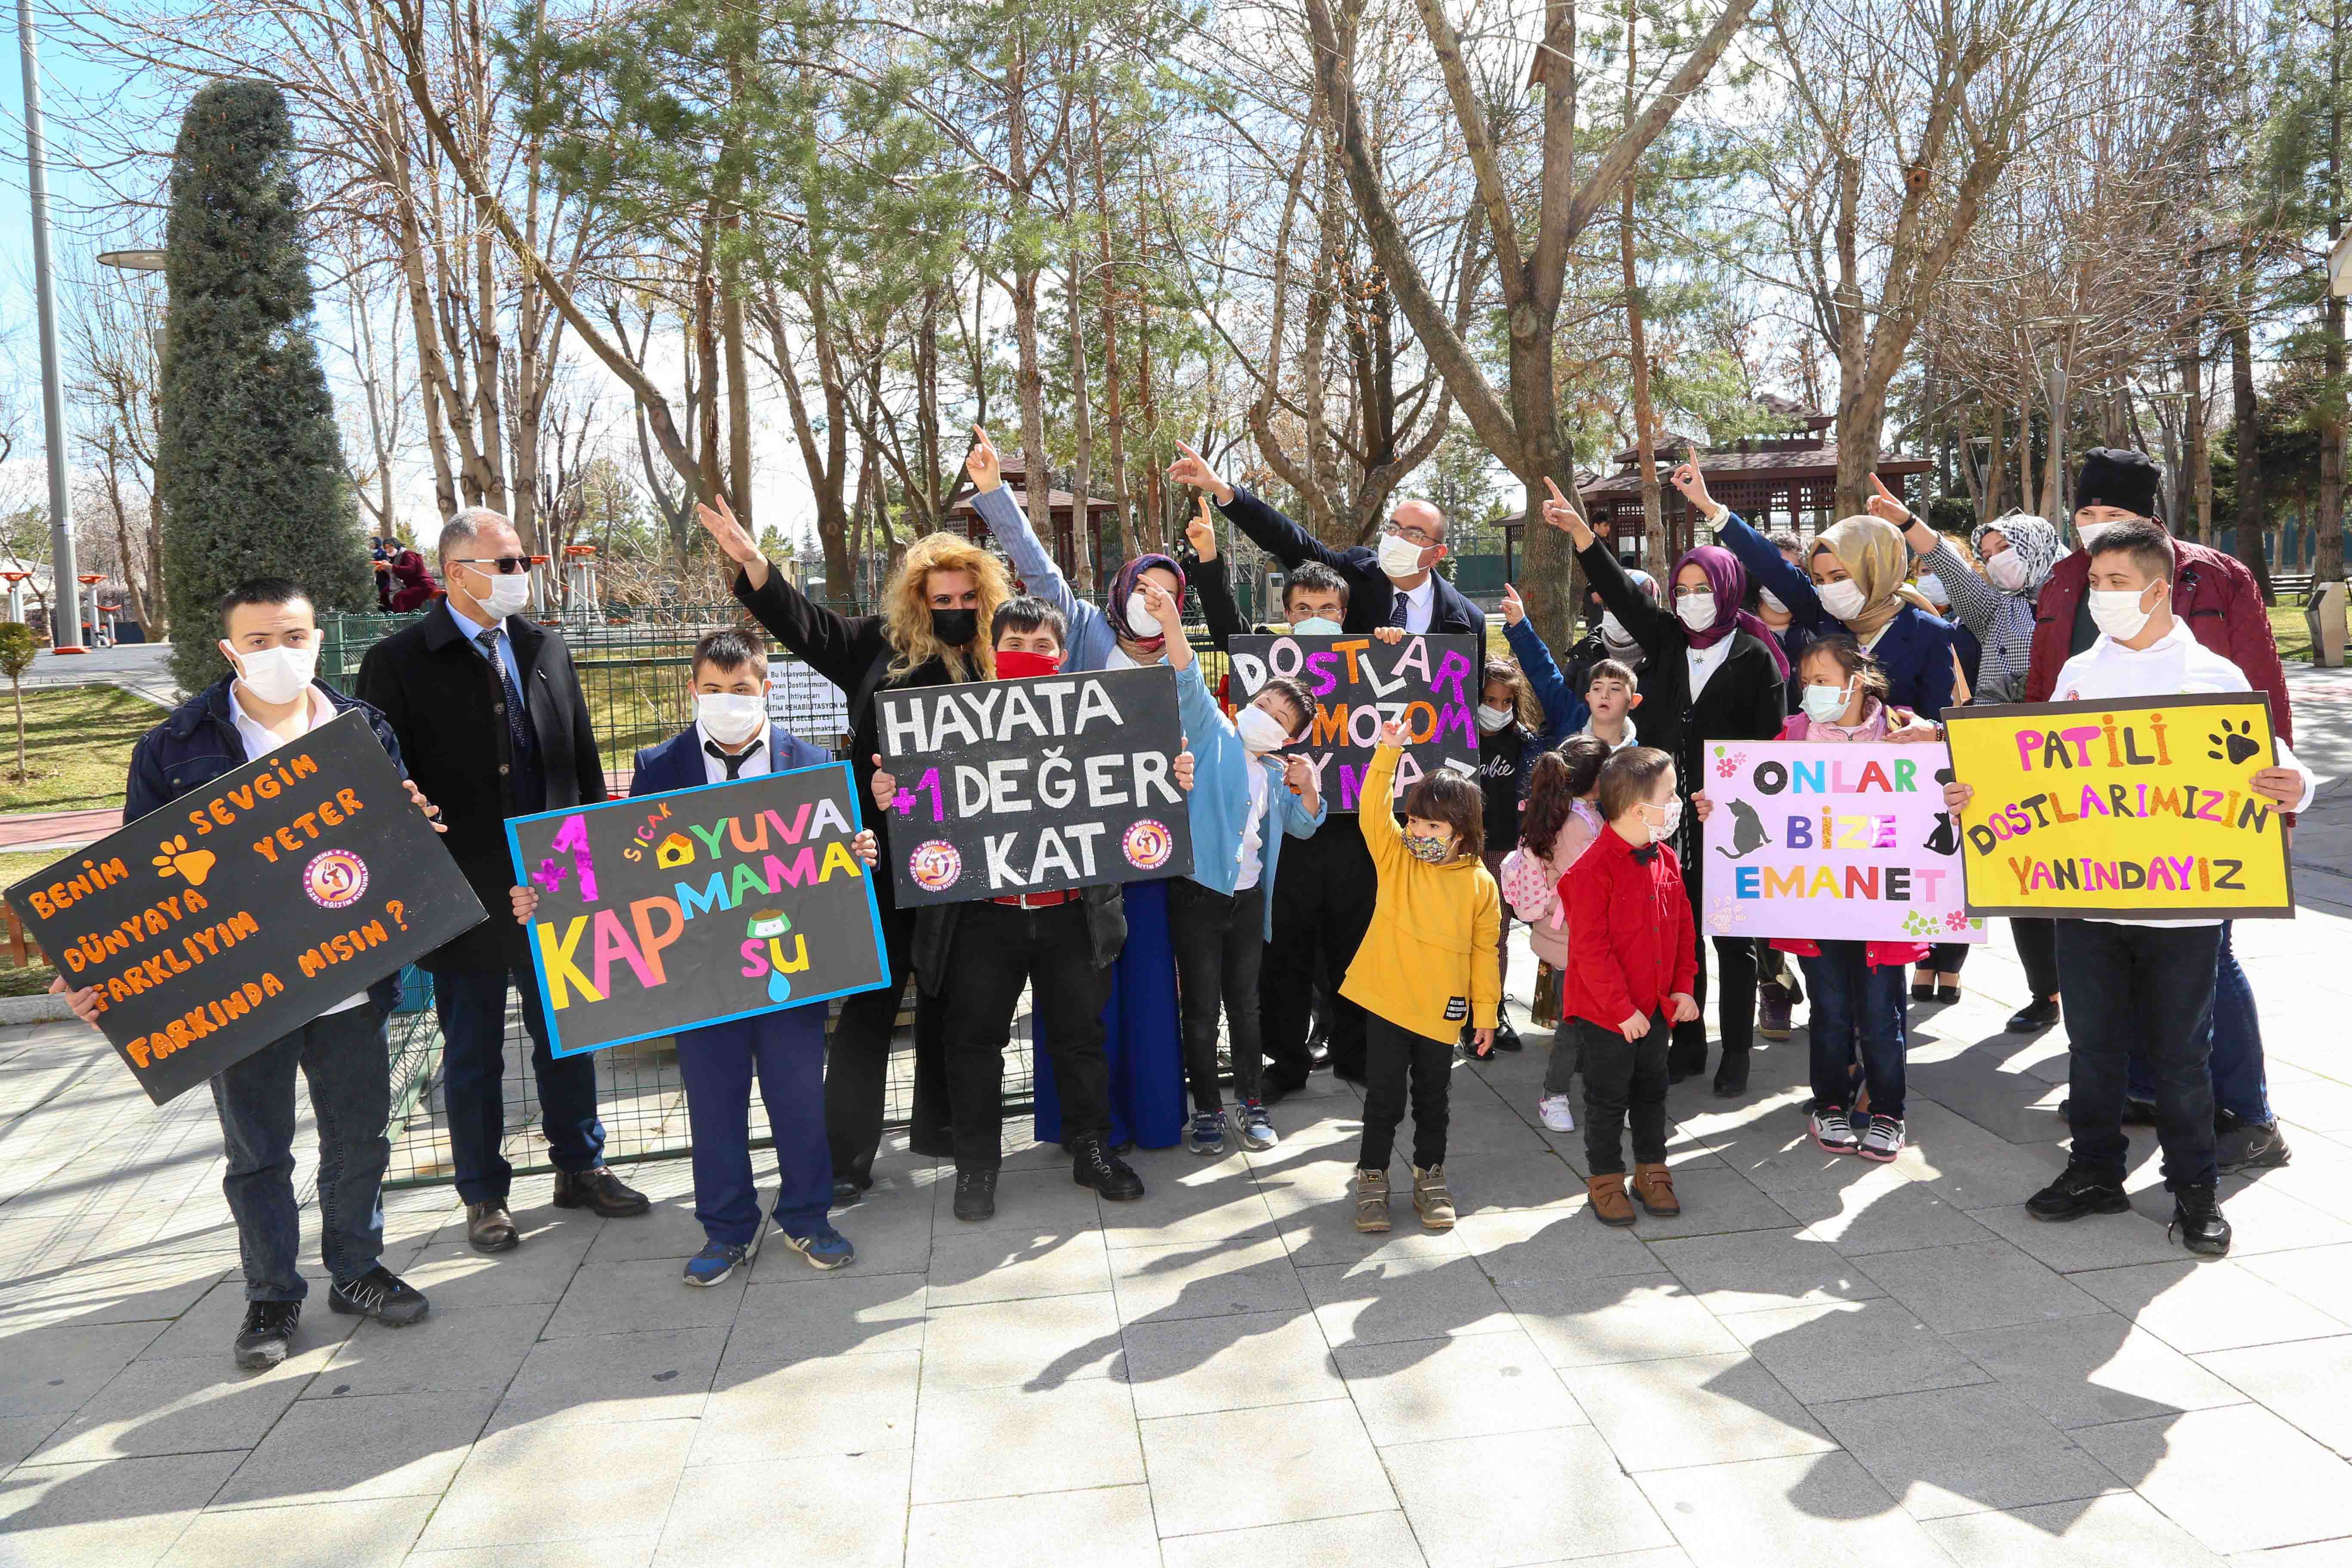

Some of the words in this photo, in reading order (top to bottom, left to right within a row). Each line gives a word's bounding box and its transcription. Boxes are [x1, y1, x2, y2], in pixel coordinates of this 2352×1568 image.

[1232, 636, 1470, 704] DOSTLAR
[883, 679, 1123, 756] HAYATA
[2015, 713, 2173, 771] PATİLİ
[891, 767, 944, 821] +1
[954, 745, 1182, 819] DEĞER
[1480, 754, 1515, 778] arbie
[1753, 759, 1917, 795] ONLAR
[29, 858, 129, 920] BENİM
[189, 754, 318, 835] SEVGİM
[624, 803, 672, 863] SICAK
[689, 798, 852, 859] YUVA
[1787, 806, 1896, 849] BİZE
[1967, 784, 2269, 856] DOSTLARIMIZIN
[64, 889, 208, 973] DÜNYAYA
[253, 788, 364, 862] YETER
[307, 887, 321, 904] ÖZEL
[352, 859, 369, 901] KURUMLARI
[312, 851, 333, 864] DEHA
[532, 815, 599, 902] +1
[674, 842, 861, 921] MAMA
[984, 821, 1106, 890] KAT
[1736, 866, 1945, 902] EMANET
[2008, 856, 2245, 895] YANINDAYIZ
[93, 911, 258, 1012] FARKLIYIM
[126, 973, 284, 1068] FARKINDA
[298, 920, 388, 978] MISIN
[386, 900, 409, 932] ?
[537, 896, 685, 1010] KAP
